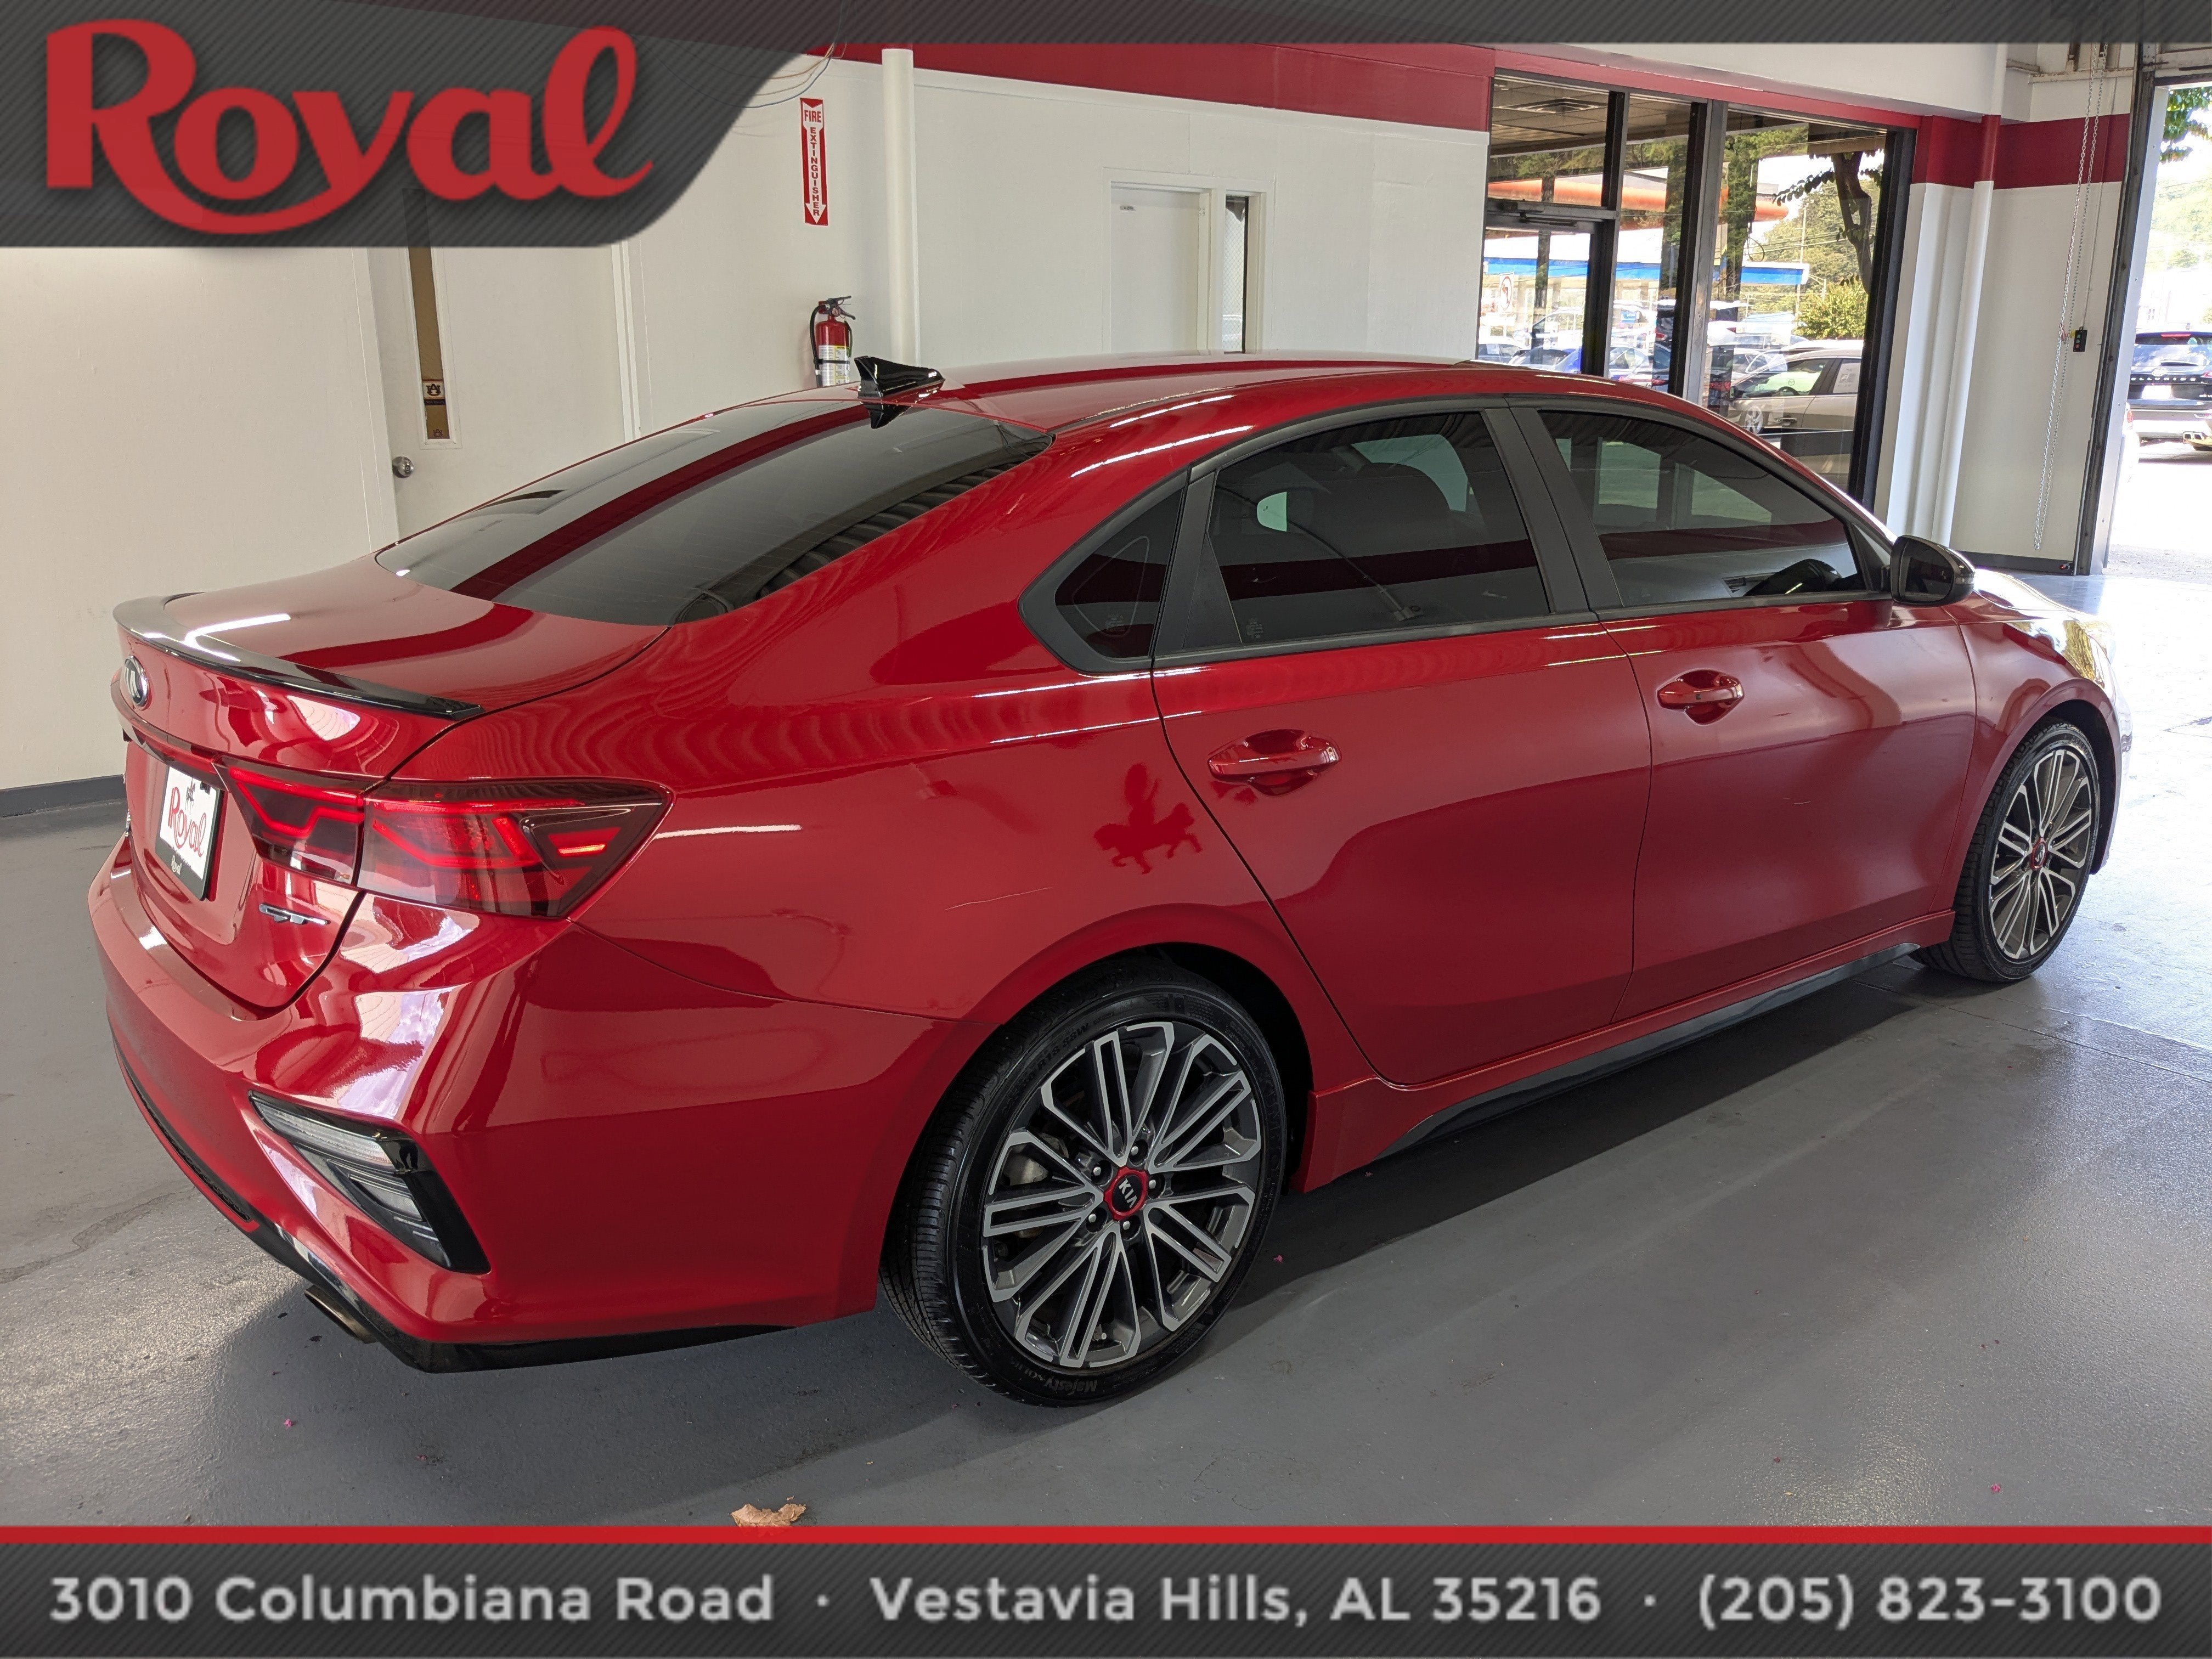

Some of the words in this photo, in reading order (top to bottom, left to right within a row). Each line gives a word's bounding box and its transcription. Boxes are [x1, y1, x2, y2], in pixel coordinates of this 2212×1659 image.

[804, 110, 822, 123] FIRE
[809, 127, 820, 216] EXTINGUISHER
[168, 786, 207, 857] Royal
[1118, 1178, 1138, 1209] KIA
